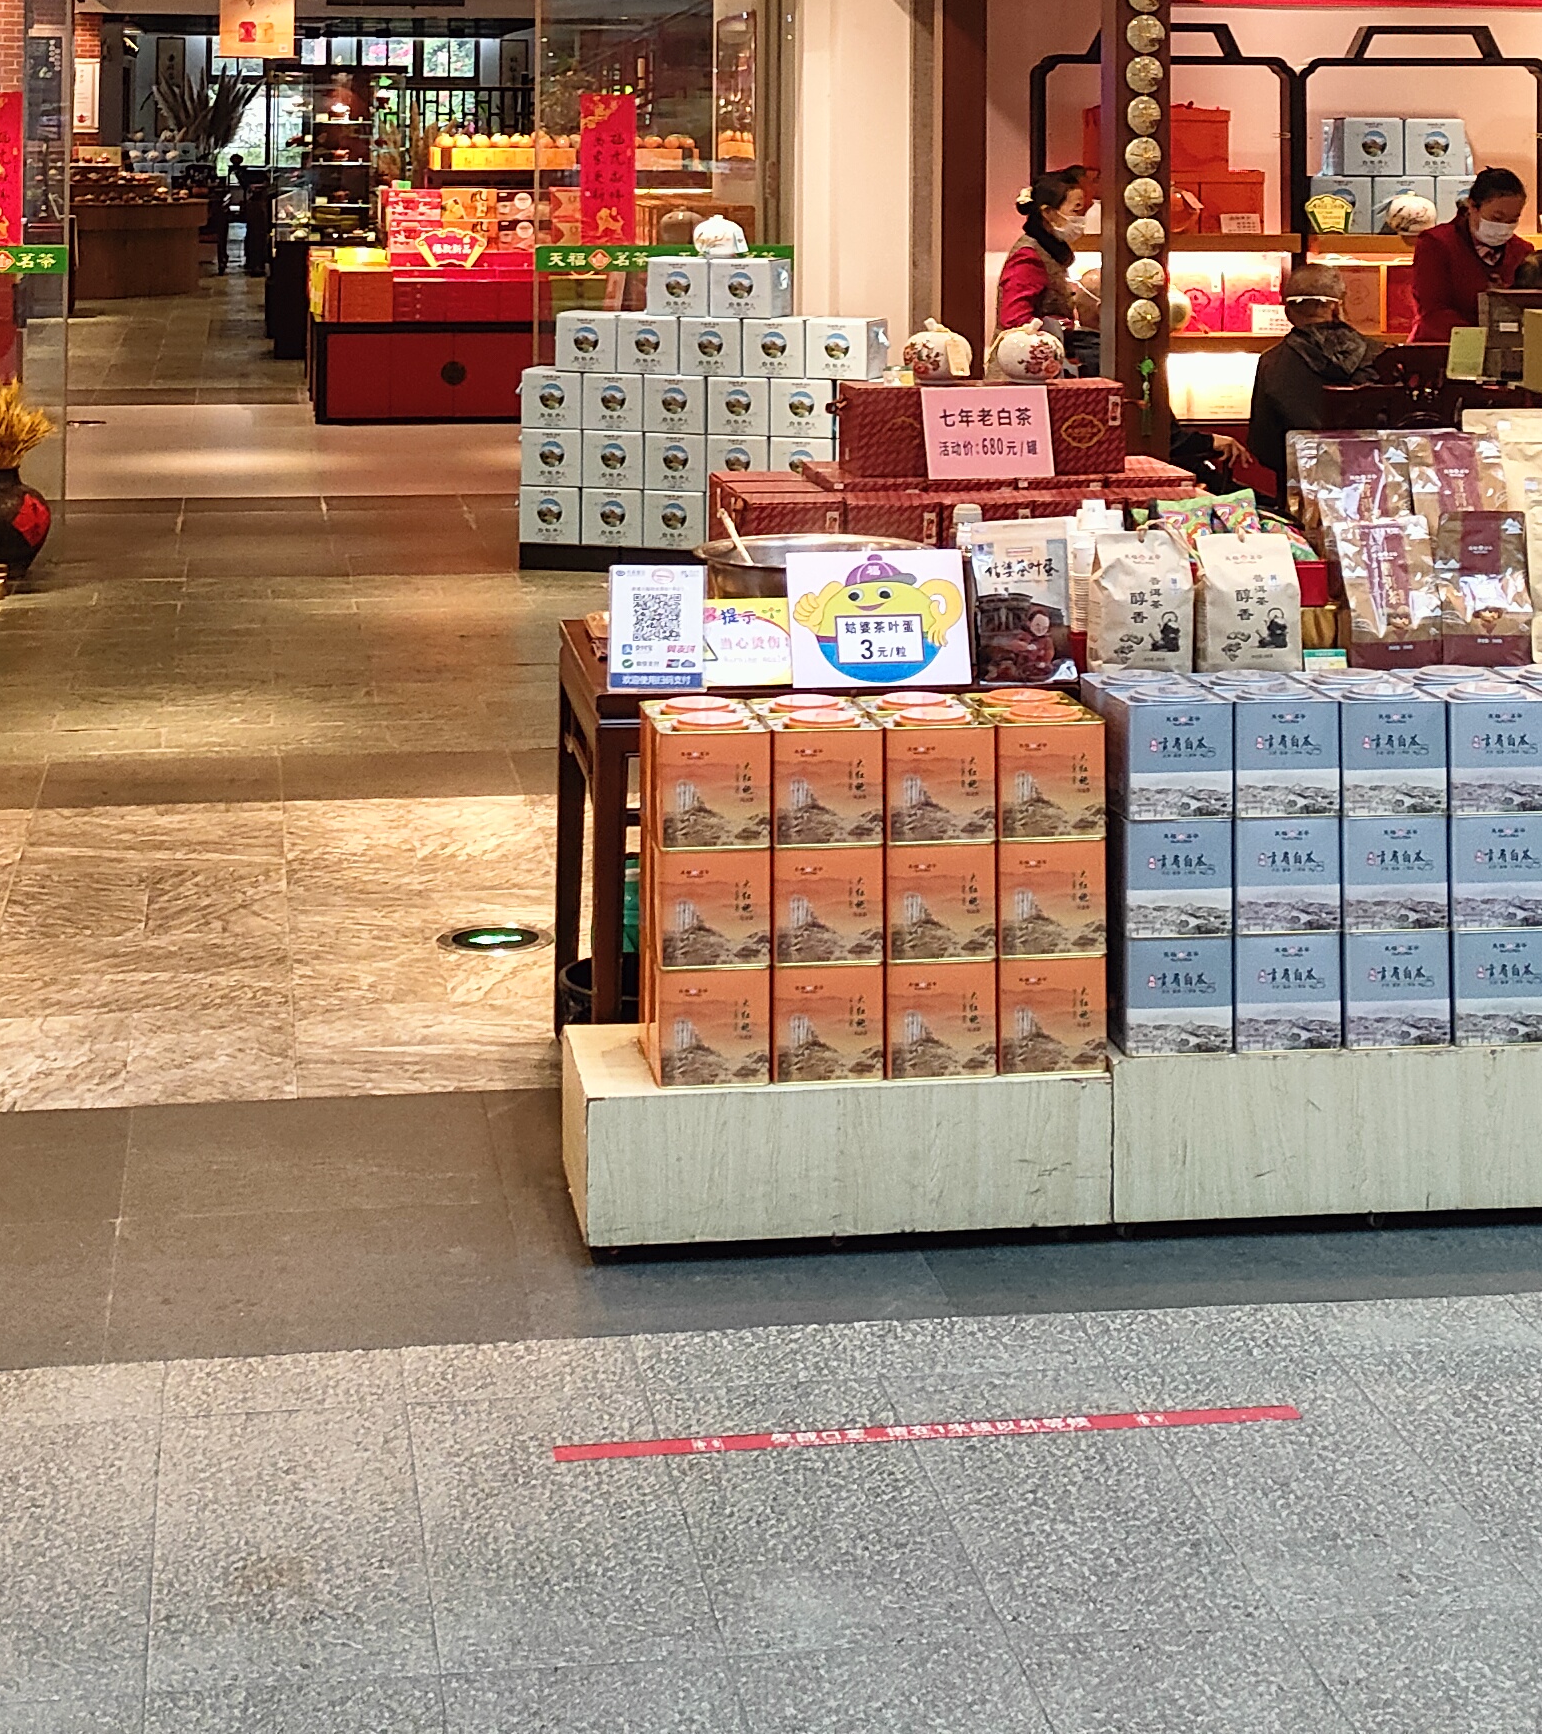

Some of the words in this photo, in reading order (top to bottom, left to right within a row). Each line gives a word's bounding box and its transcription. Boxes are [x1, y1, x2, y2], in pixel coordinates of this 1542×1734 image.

[940, 407, 1032, 427] 七年老白茶
[1129, 591, 1149, 624] 醇香
[1234, 588, 1255, 622] 醇香
[844, 619, 915, 635] 姑婆茶叶蛋
